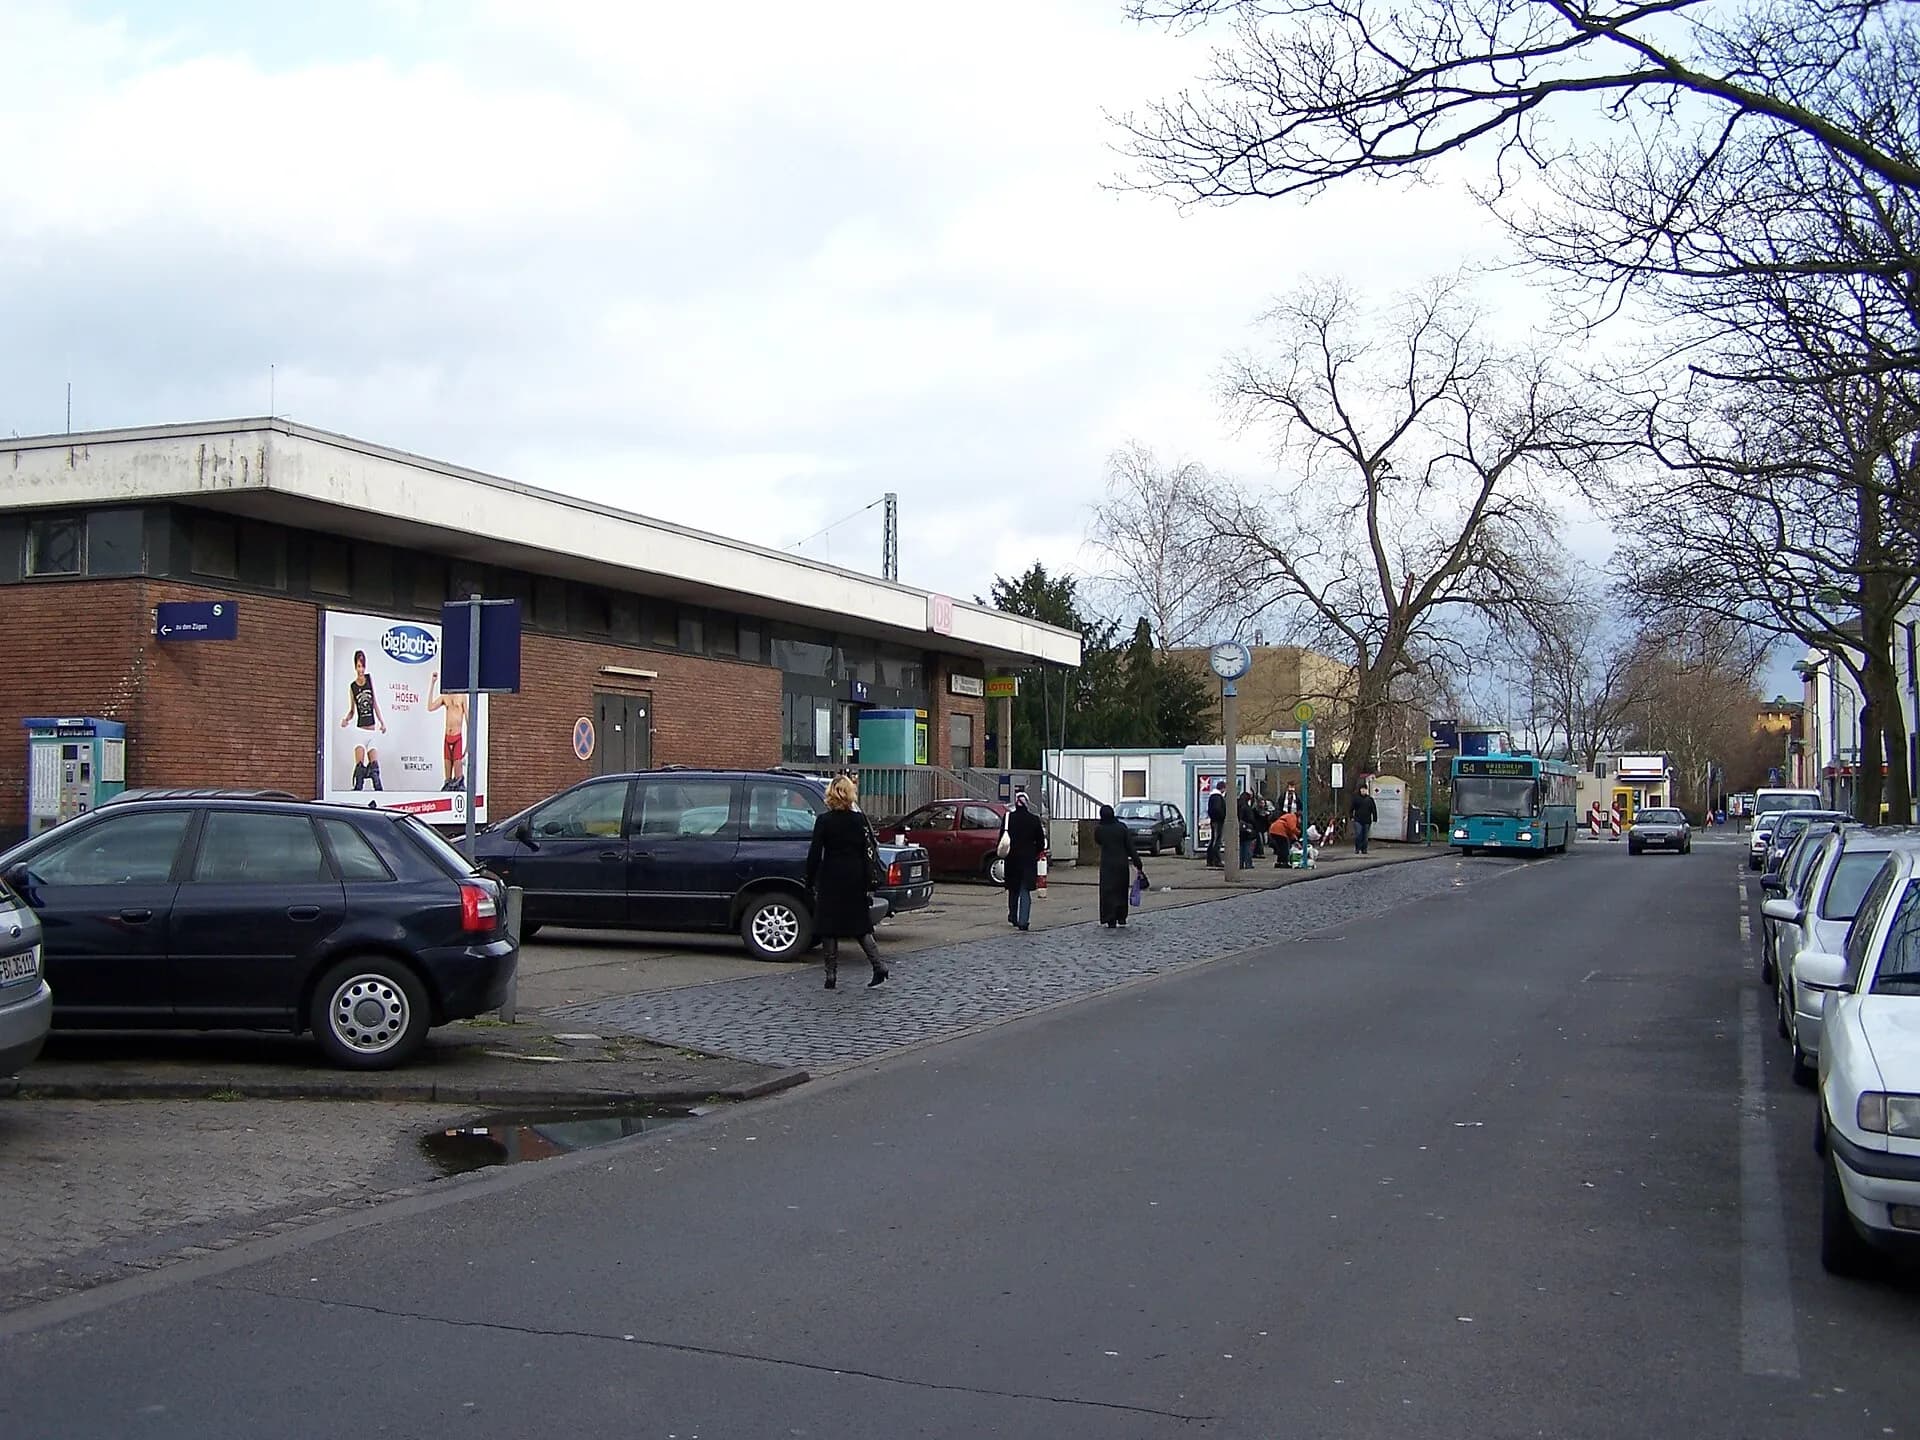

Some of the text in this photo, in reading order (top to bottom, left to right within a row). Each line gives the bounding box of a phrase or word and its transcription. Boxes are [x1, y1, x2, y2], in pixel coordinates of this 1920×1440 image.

[213, 604, 222, 616] S
[936, 603, 950, 627] DB
[192, 623, 208, 631] Zügen
[382, 630, 438, 656] Big Brother
[987, 682, 1013, 691] LOTTO
[395, 692, 419, 703] HOSEN
[1300, 705, 1309, 719] H
[59, 728, 95, 736] Fahrkarten
[1462, 763, 1475, 773] 54
